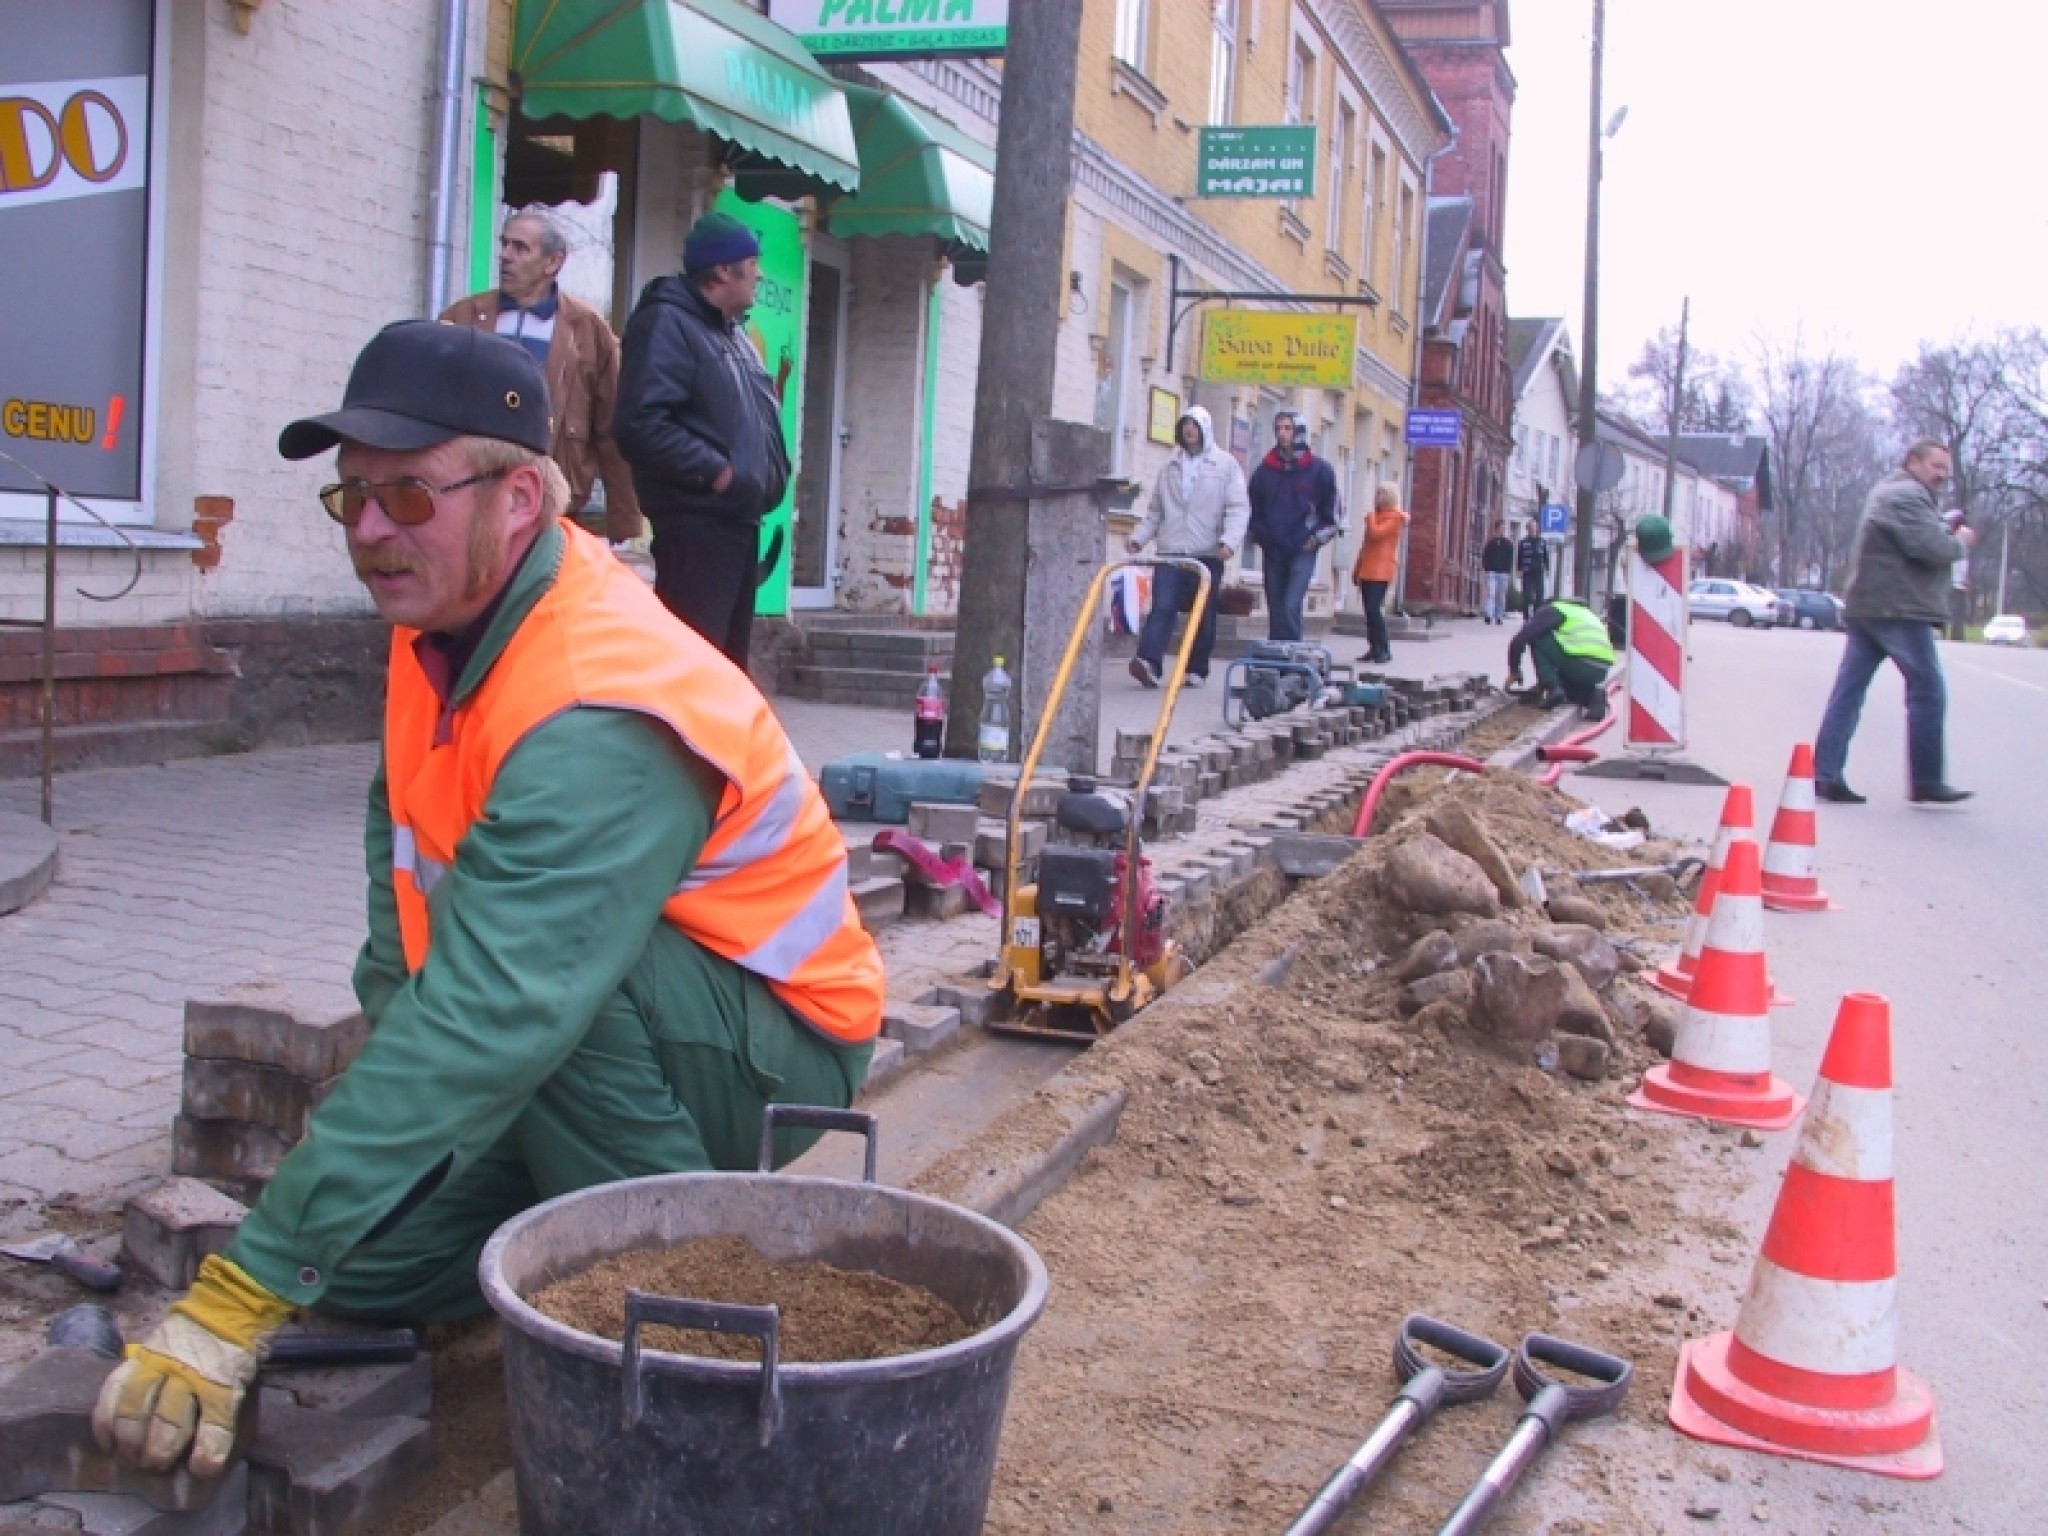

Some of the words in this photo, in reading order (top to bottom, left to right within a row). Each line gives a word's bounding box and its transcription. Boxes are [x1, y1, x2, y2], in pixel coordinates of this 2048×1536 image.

[818, 0, 974, 26] PALMA
[724, 47, 812, 130] PALMA
[0, 89, 128, 193] DO
[1546, 508, 1563, 528] P
